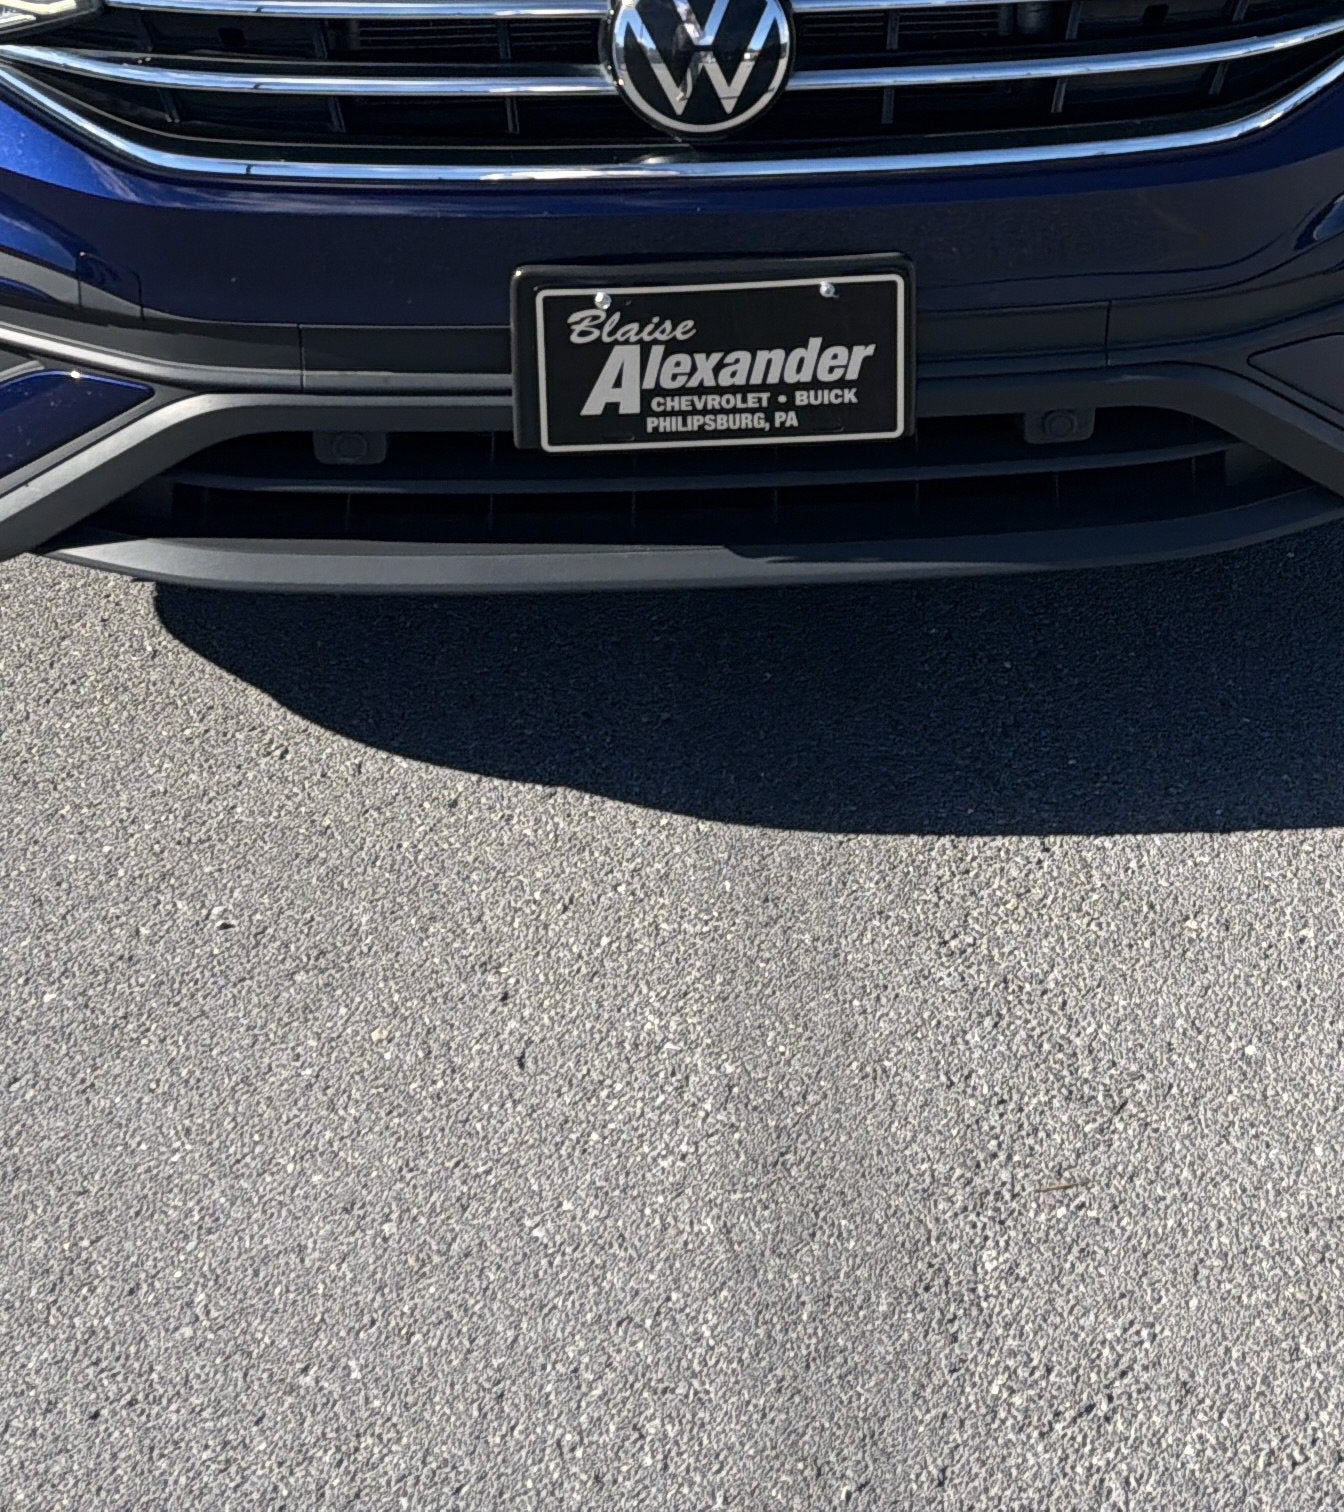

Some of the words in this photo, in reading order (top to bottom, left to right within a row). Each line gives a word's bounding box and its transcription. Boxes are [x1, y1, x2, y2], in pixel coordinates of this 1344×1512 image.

[567, 309, 697, 345] Blaise
[579, 336, 877, 416] Alexander
[651, 392, 770, 413] CHEVROLET
[794, 388, 858, 407] BUICK
[646, 412, 771, 434] PHILIPSBURG,
[774, 411, 799, 429] PA
